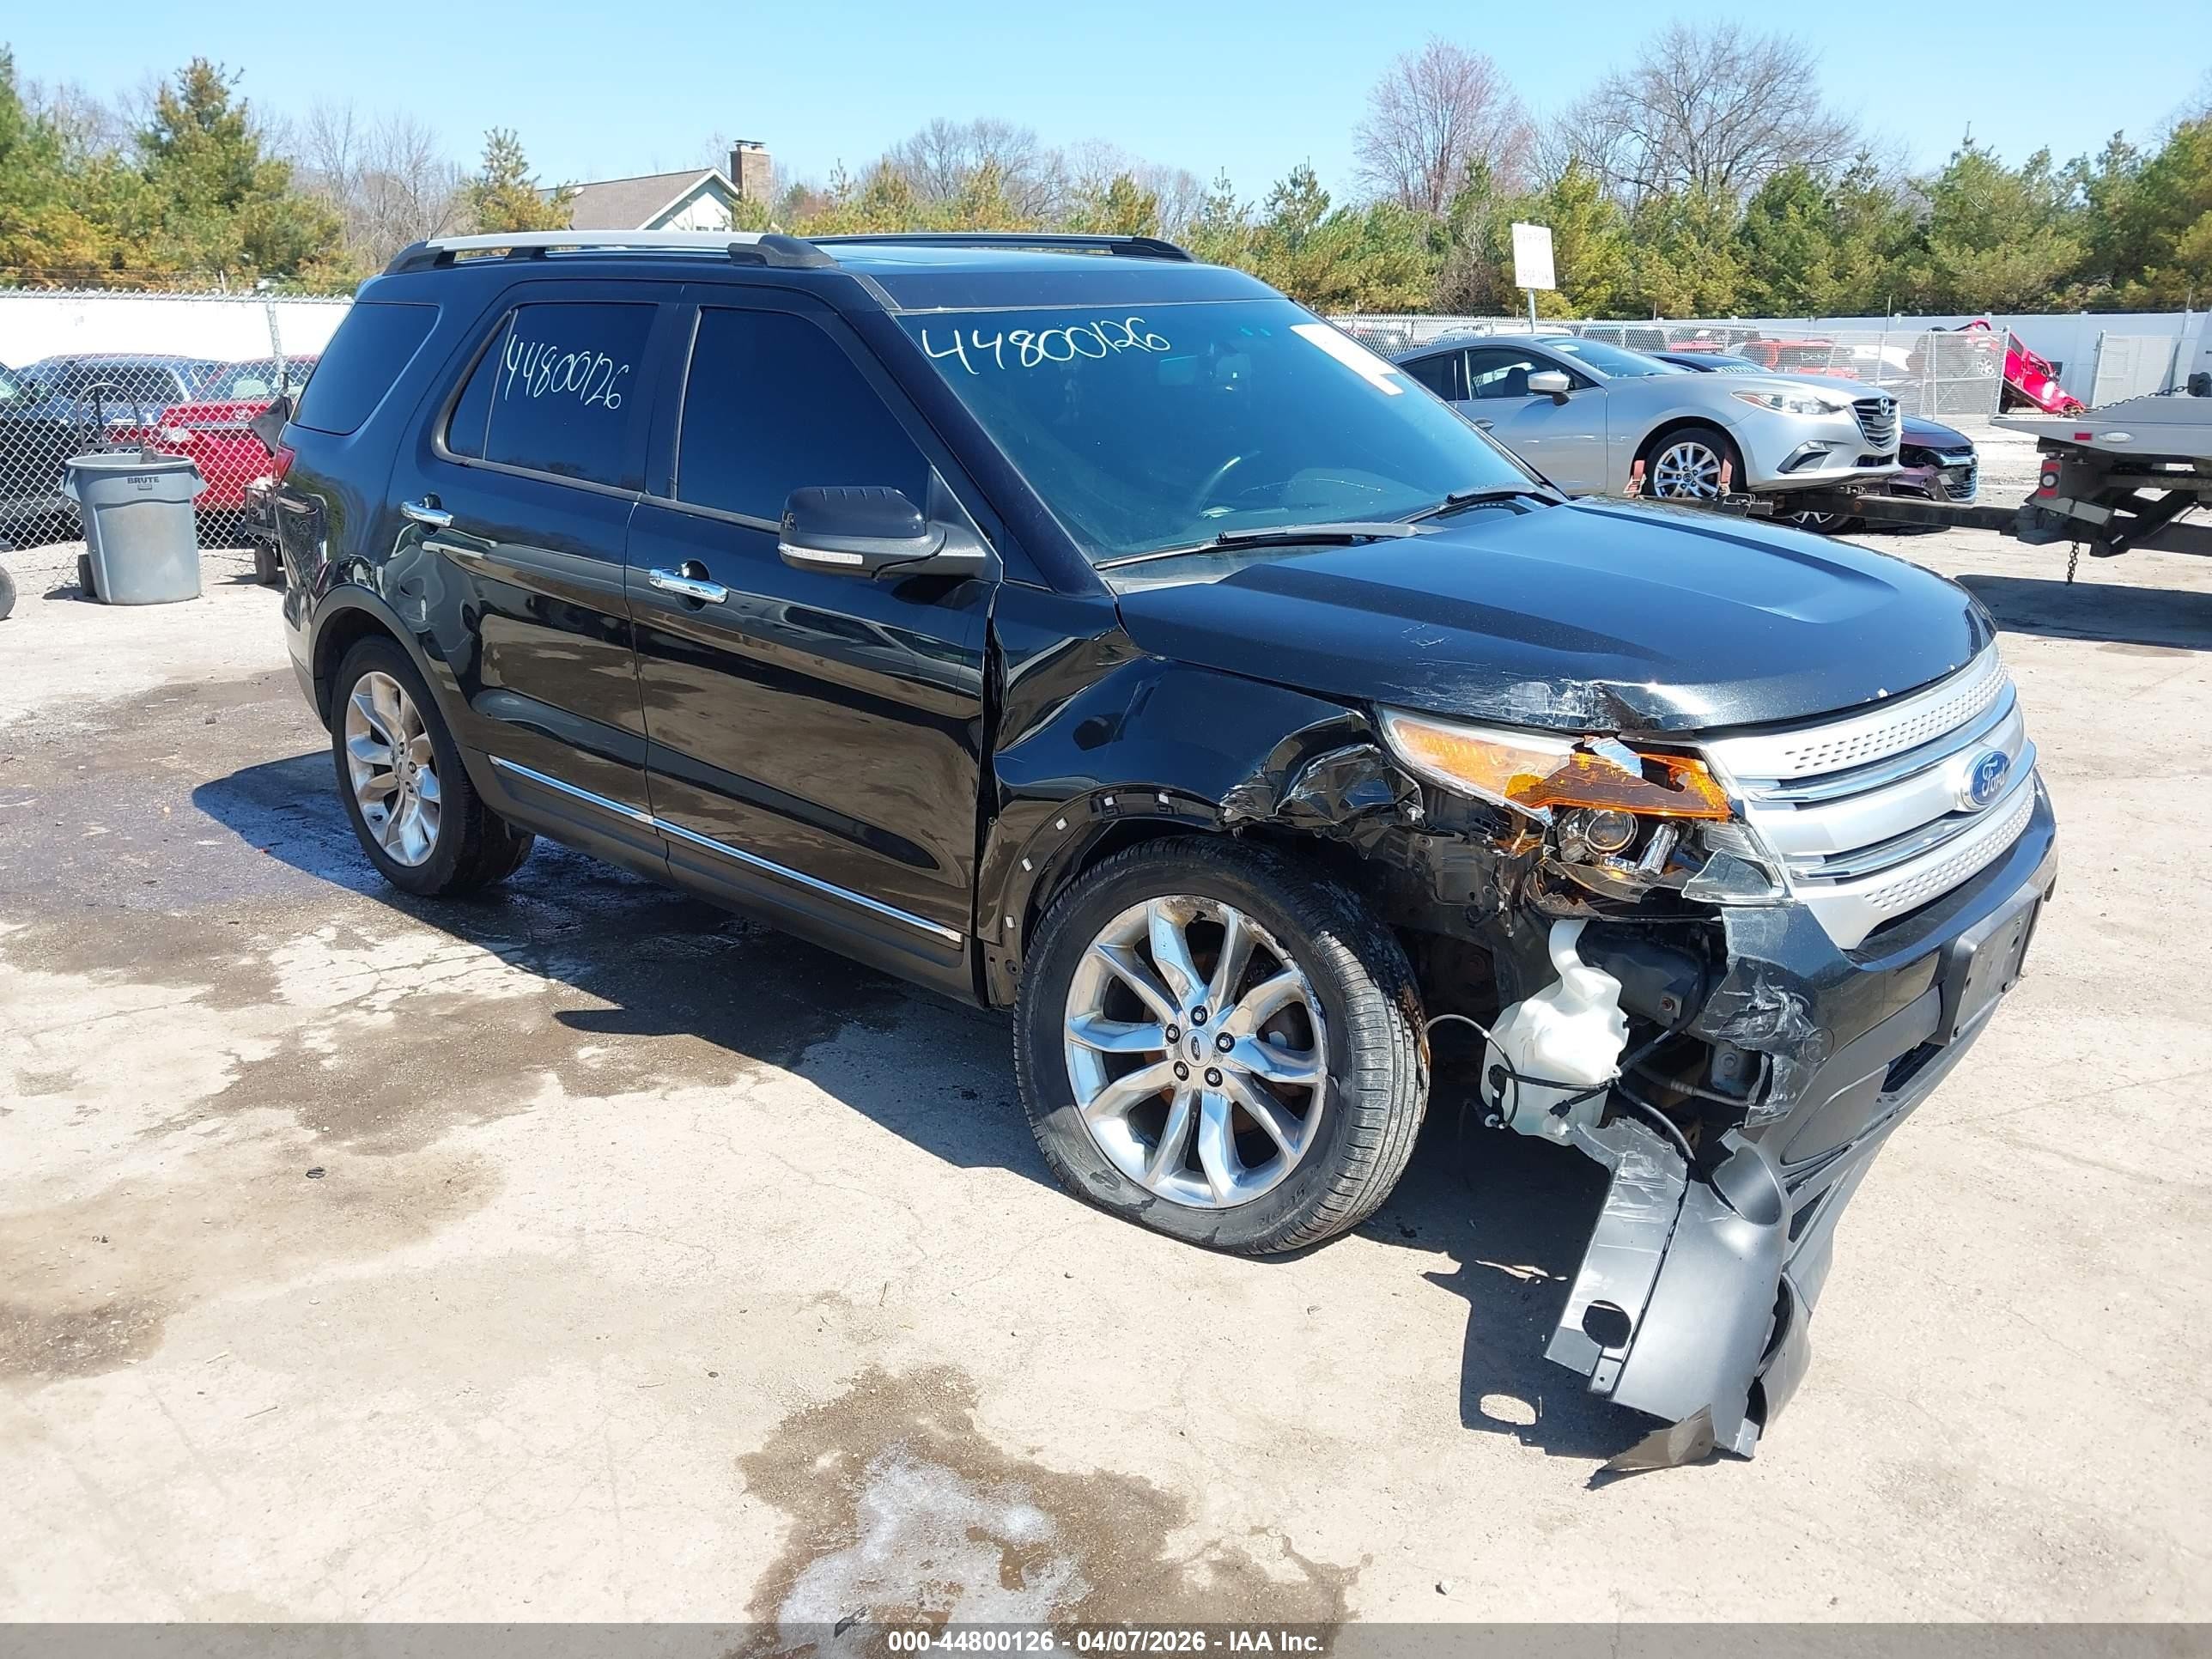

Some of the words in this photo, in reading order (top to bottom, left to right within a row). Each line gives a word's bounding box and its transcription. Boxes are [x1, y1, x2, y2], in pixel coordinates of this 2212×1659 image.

[504, 333, 629, 410] 44800126
[921, 316, 1172, 375] 44800126
[1981, 759, 2005, 798] Ford
